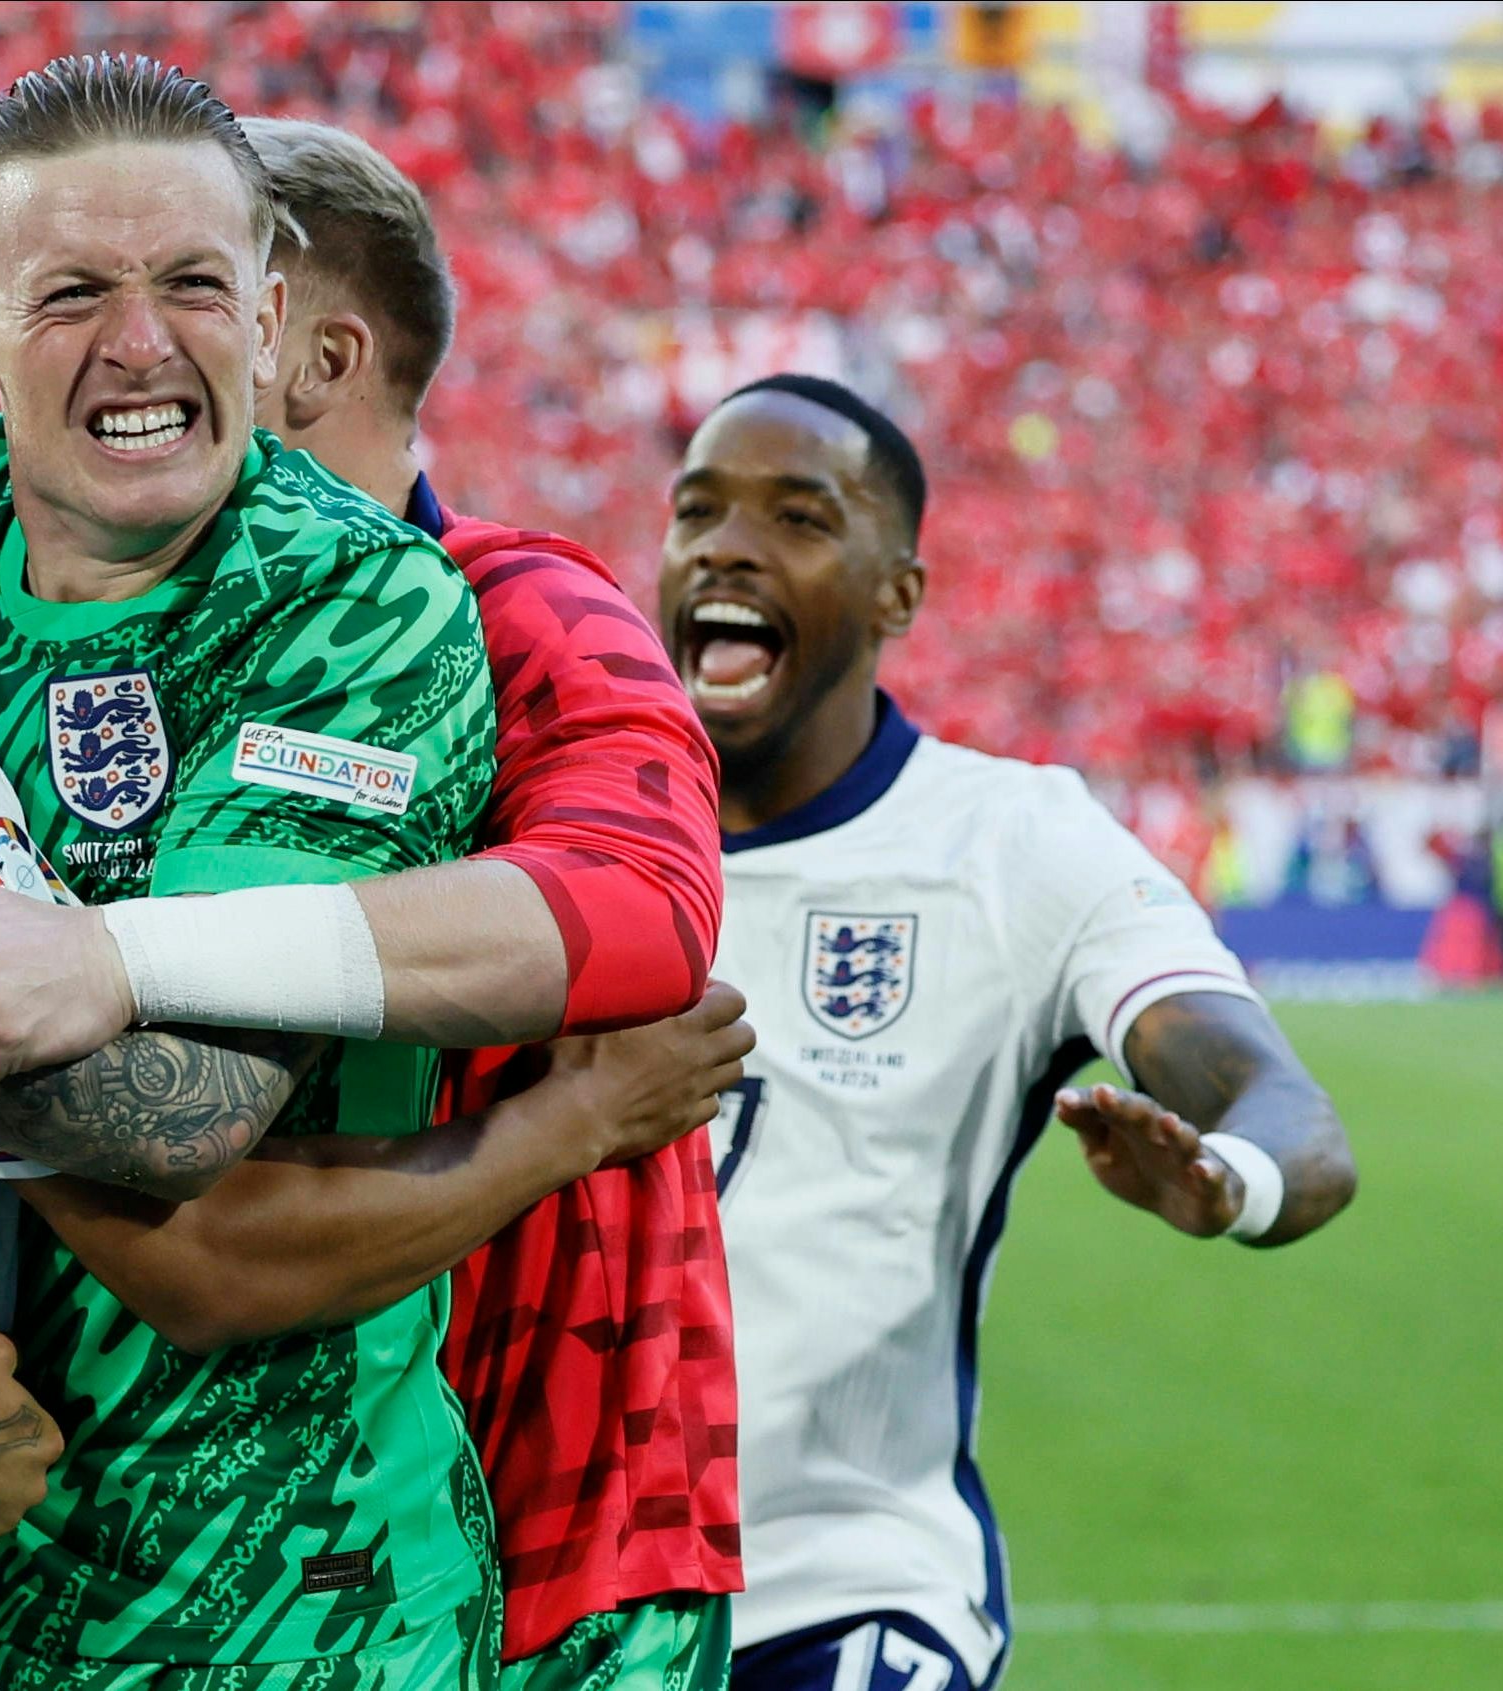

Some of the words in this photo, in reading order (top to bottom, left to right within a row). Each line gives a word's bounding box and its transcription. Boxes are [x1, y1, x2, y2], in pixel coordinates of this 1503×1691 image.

[243, 727, 285, 742] UEFA
[239, 741, 410, 794] FOUNDATION
[353, 788, 367, 802] for
